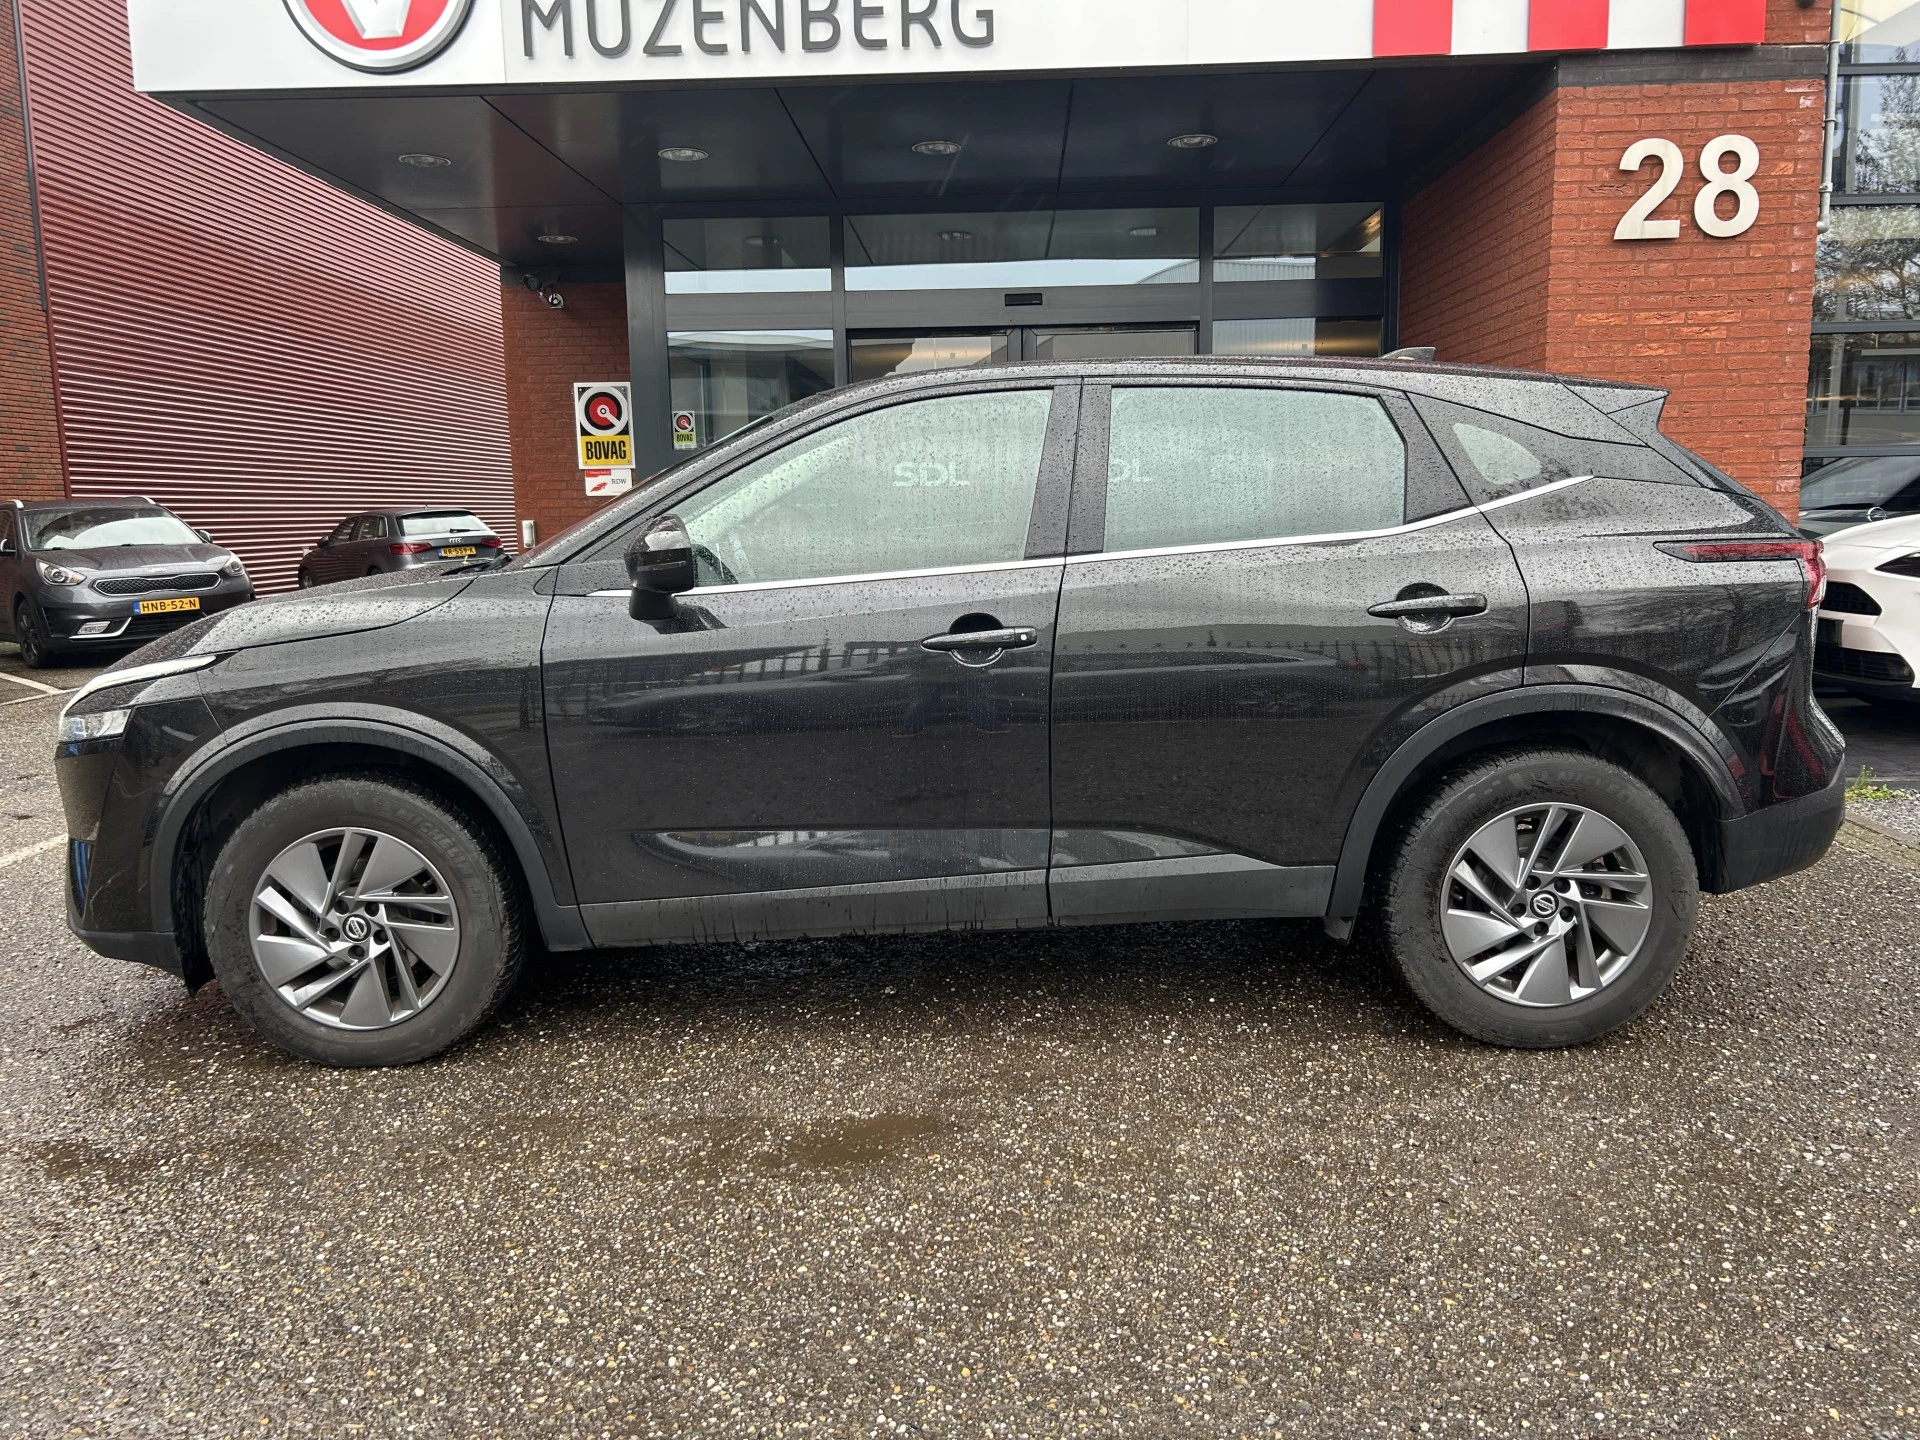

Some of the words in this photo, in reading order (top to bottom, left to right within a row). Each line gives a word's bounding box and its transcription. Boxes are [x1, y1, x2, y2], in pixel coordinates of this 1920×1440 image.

[1613, 134, 1760, 240] 28
[676, 433, 693, 443] BOVAG
[585, 440, 627, 460] BOVAG
[892, 460, 971, 488] SDL
[142, 598, 197, 613] HNB-52-N
